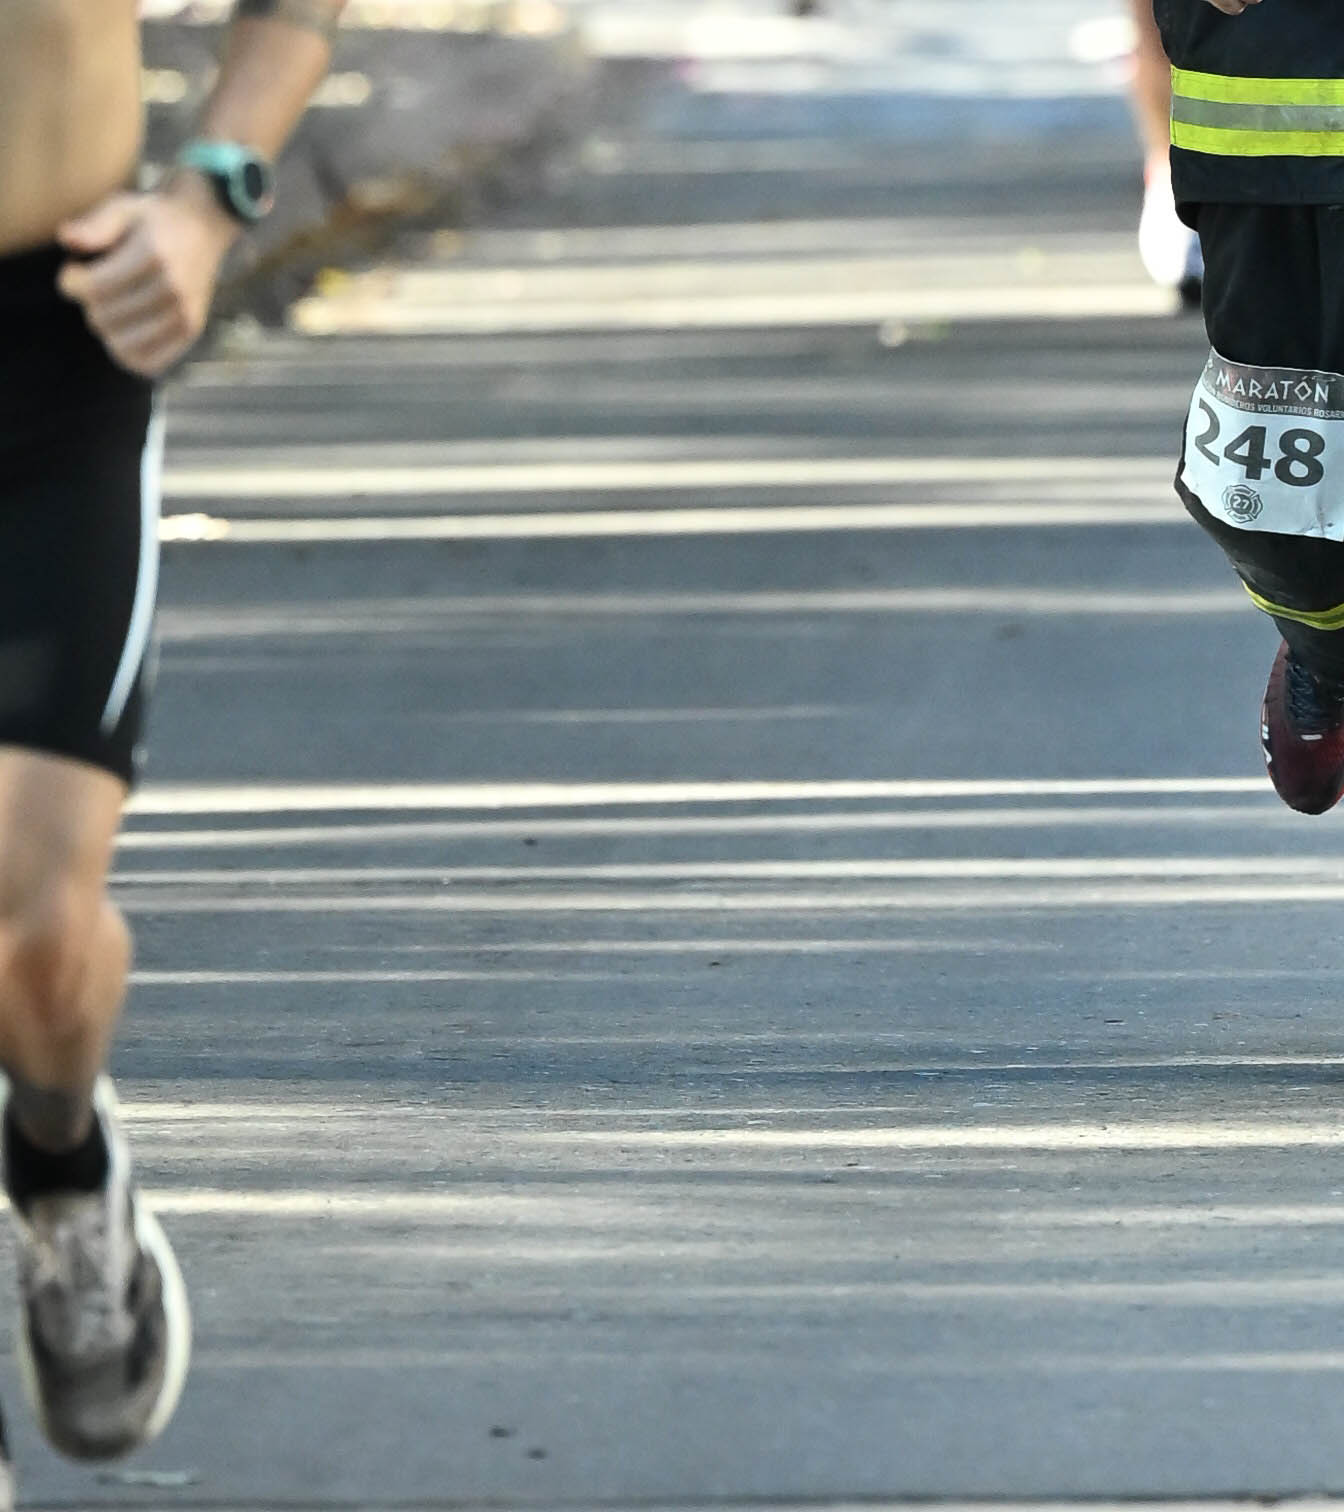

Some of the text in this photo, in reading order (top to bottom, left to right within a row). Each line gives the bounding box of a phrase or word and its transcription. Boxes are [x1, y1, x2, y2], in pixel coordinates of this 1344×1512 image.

[1215, 369, 1330, 404] MARATÓN
[1193, 397, 1326, 488] 248
[1232, 495, 1250, 510] 27
